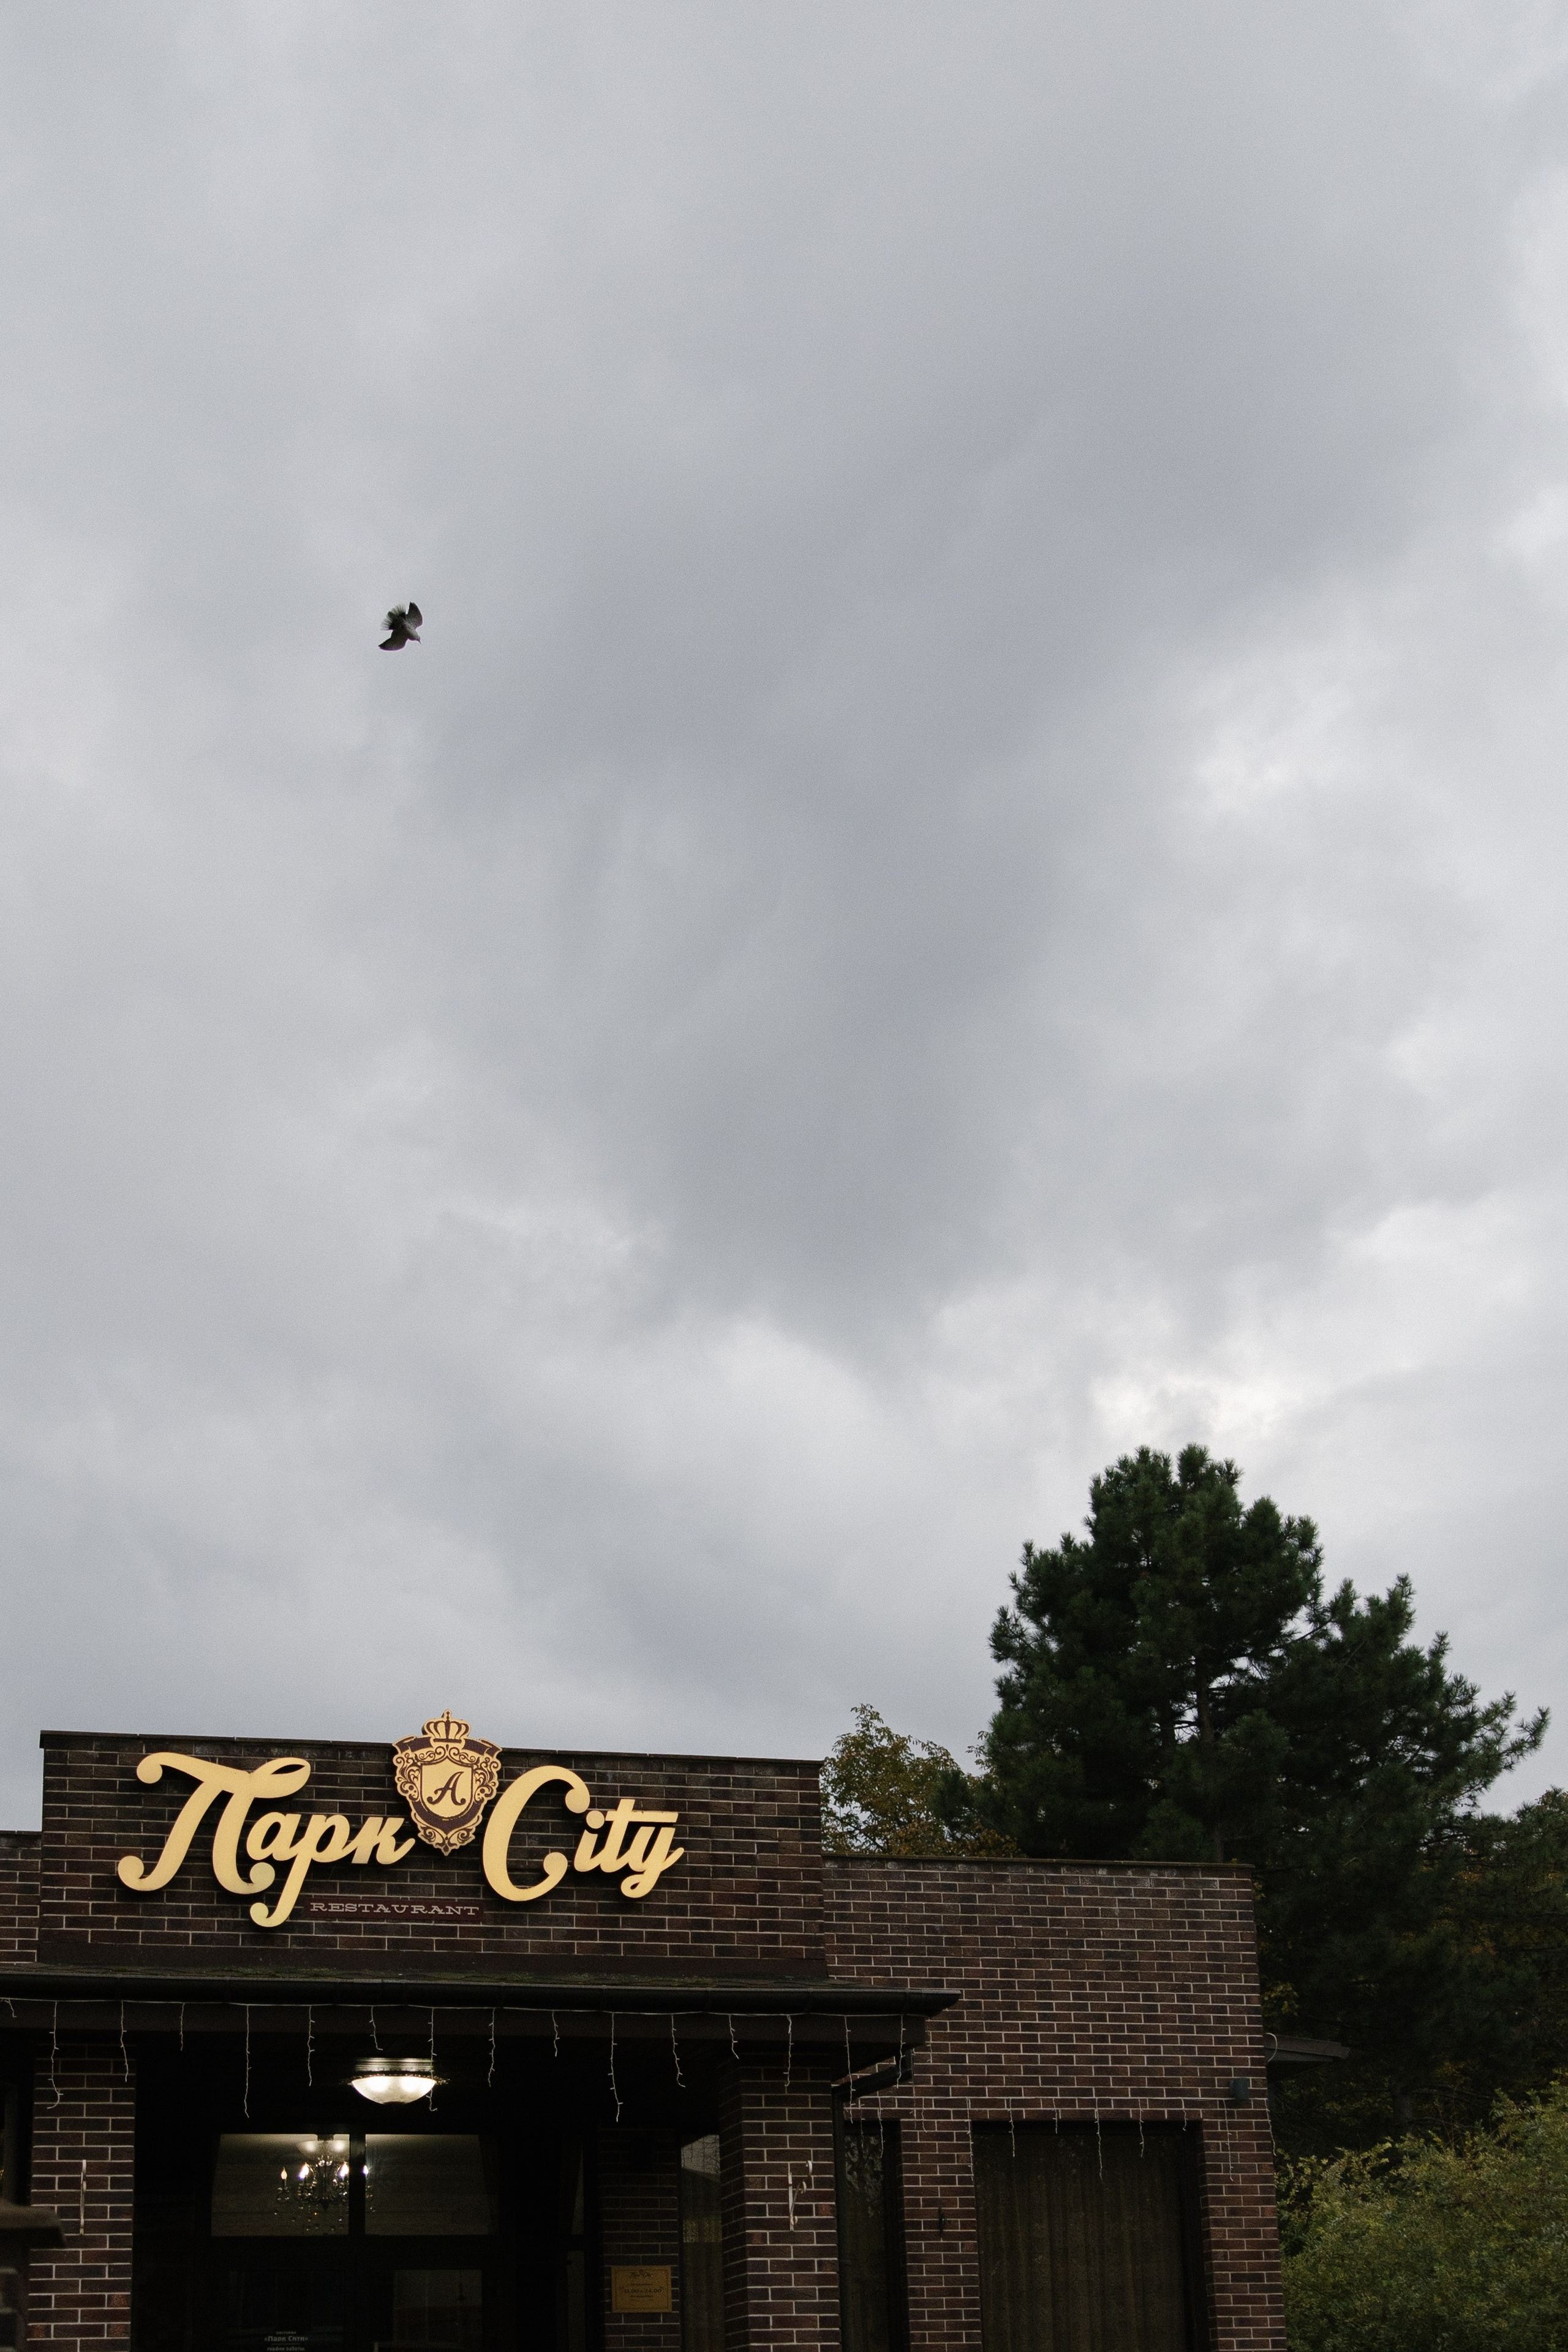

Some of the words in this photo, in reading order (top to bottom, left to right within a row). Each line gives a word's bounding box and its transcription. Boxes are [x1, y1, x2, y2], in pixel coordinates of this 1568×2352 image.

[118, 1752, 415, 1927] Парк
[483, 1765, 684, 1901] City
[310, 1902, 479, 1915] RESTAURANT
